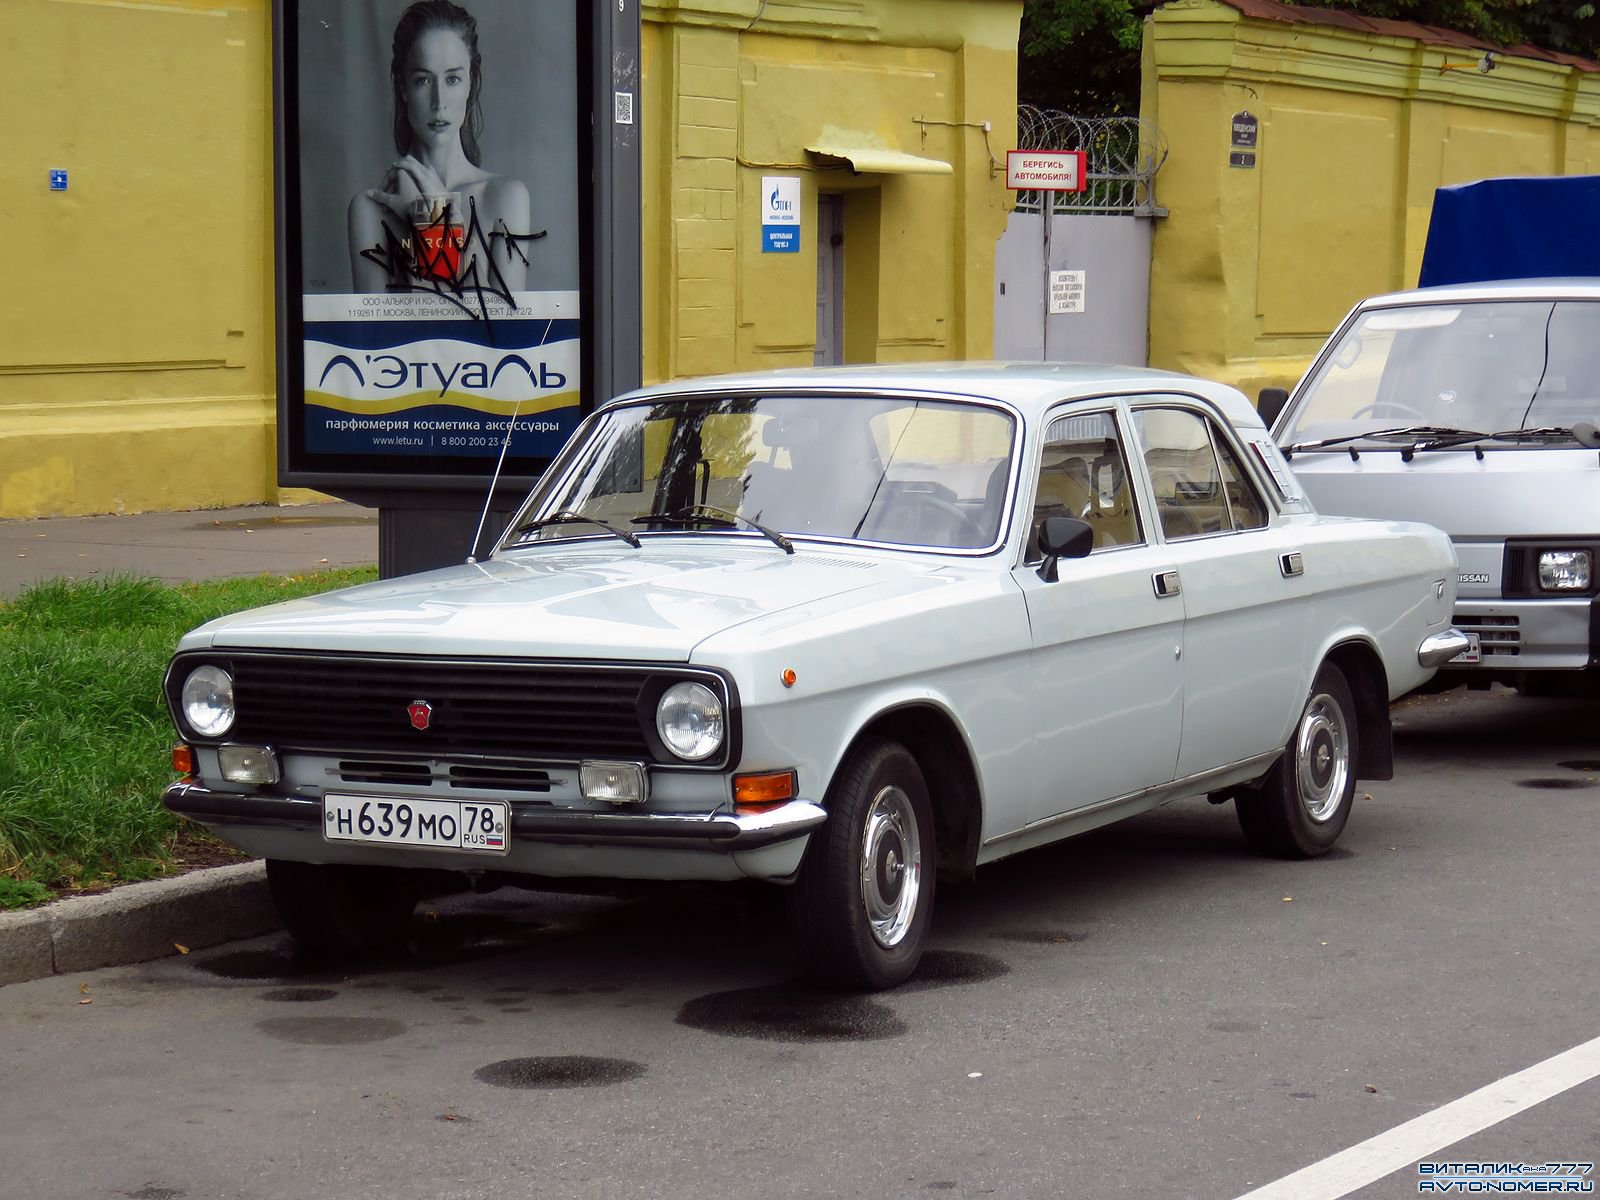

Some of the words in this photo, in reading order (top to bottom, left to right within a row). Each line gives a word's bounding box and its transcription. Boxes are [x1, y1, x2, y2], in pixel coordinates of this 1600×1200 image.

[1022, 160, 1064, 169] БЕРЕГИСЬ
[1014, 172, 1072, 181] АВТОМОБИЛЯ!
[325, 418, 409, 432] парфюмерия
[413, 420, 480, 431] косметика
[485, 421, 559, 433] аксессуары
[372, 436, 424, 446] www.letu.ru
[441, 437, 447, 446] 8
[448, 437, 467, 446] 800
[468, 437, 486, 446] 200
[488, 437, 499, 446] 23
[463, 834, 486, 845] RUS
